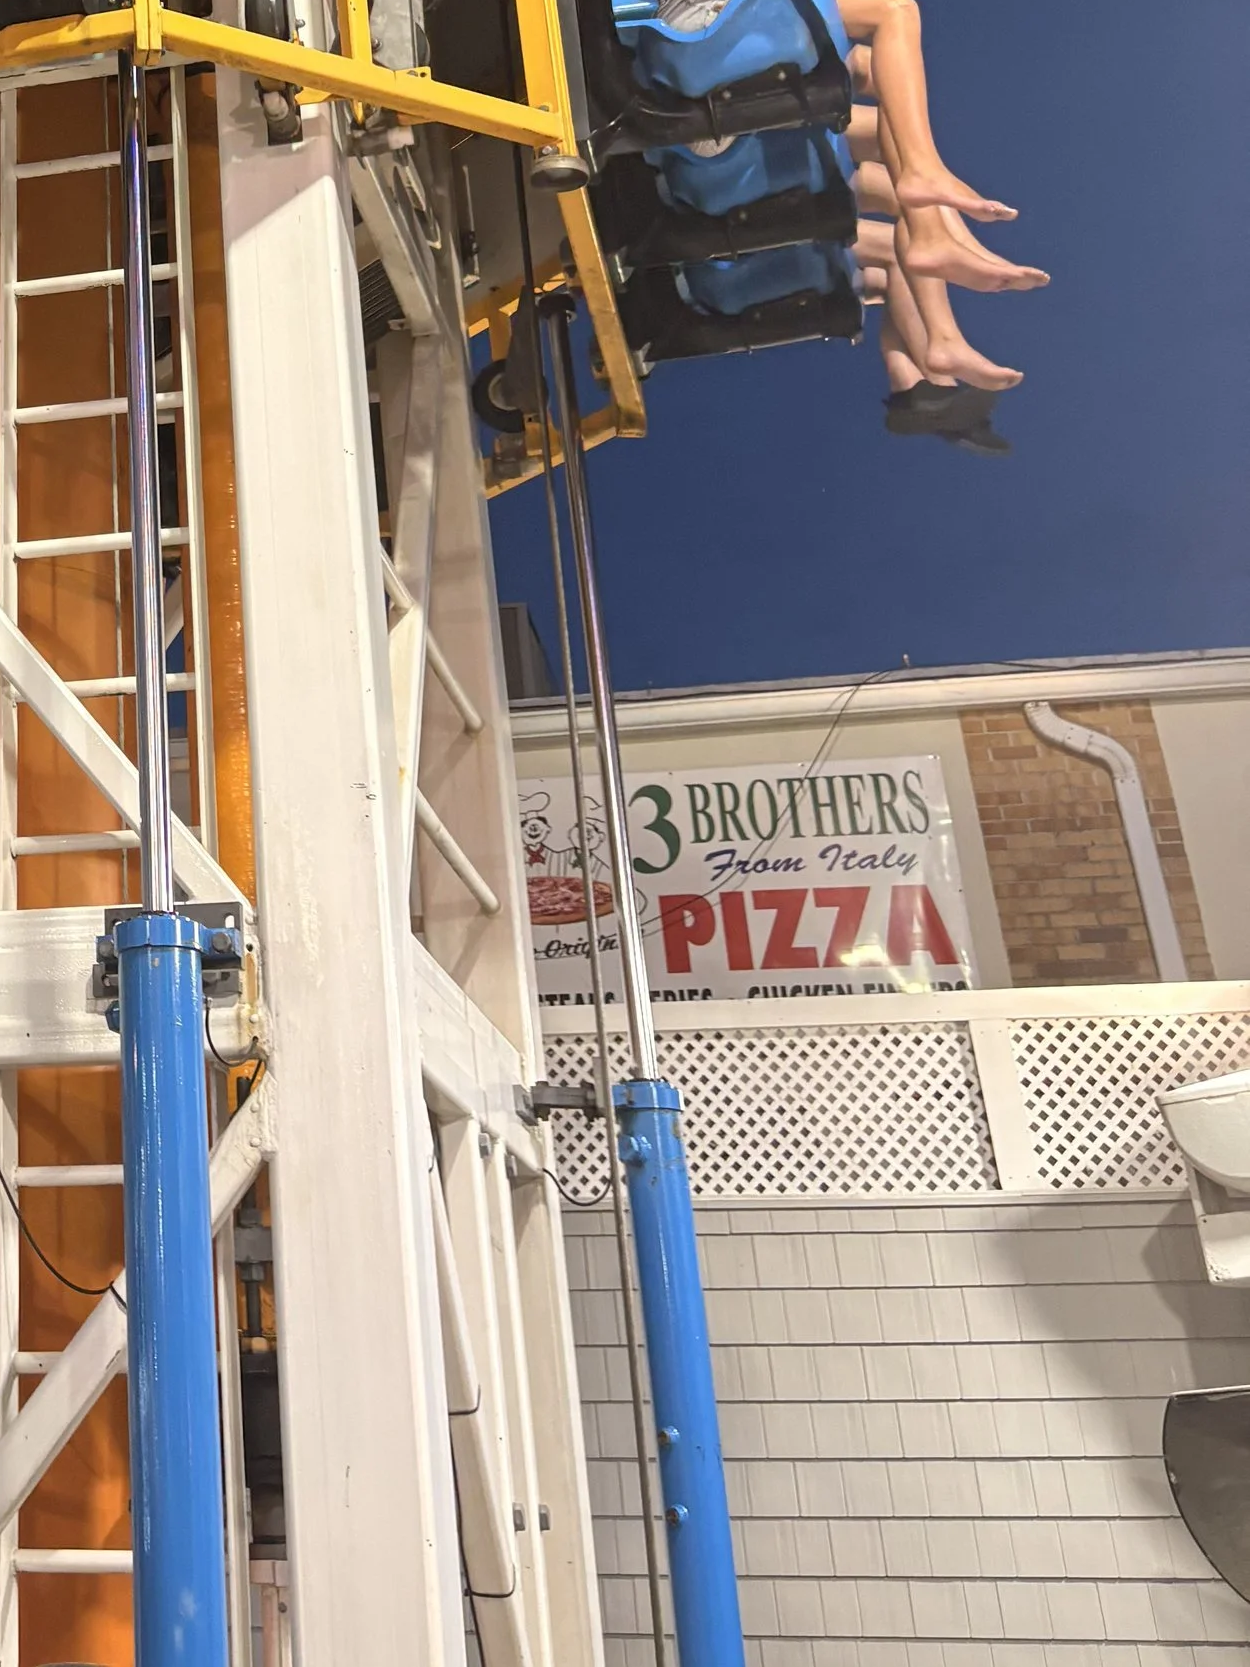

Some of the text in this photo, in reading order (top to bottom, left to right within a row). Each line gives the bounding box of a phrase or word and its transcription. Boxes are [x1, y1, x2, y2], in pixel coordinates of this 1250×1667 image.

[628, 770, 931, 875] 3 BROTHERS
[703, 843, 920, 882] From Italy
[658, 883, 961, 975] PIZZA
